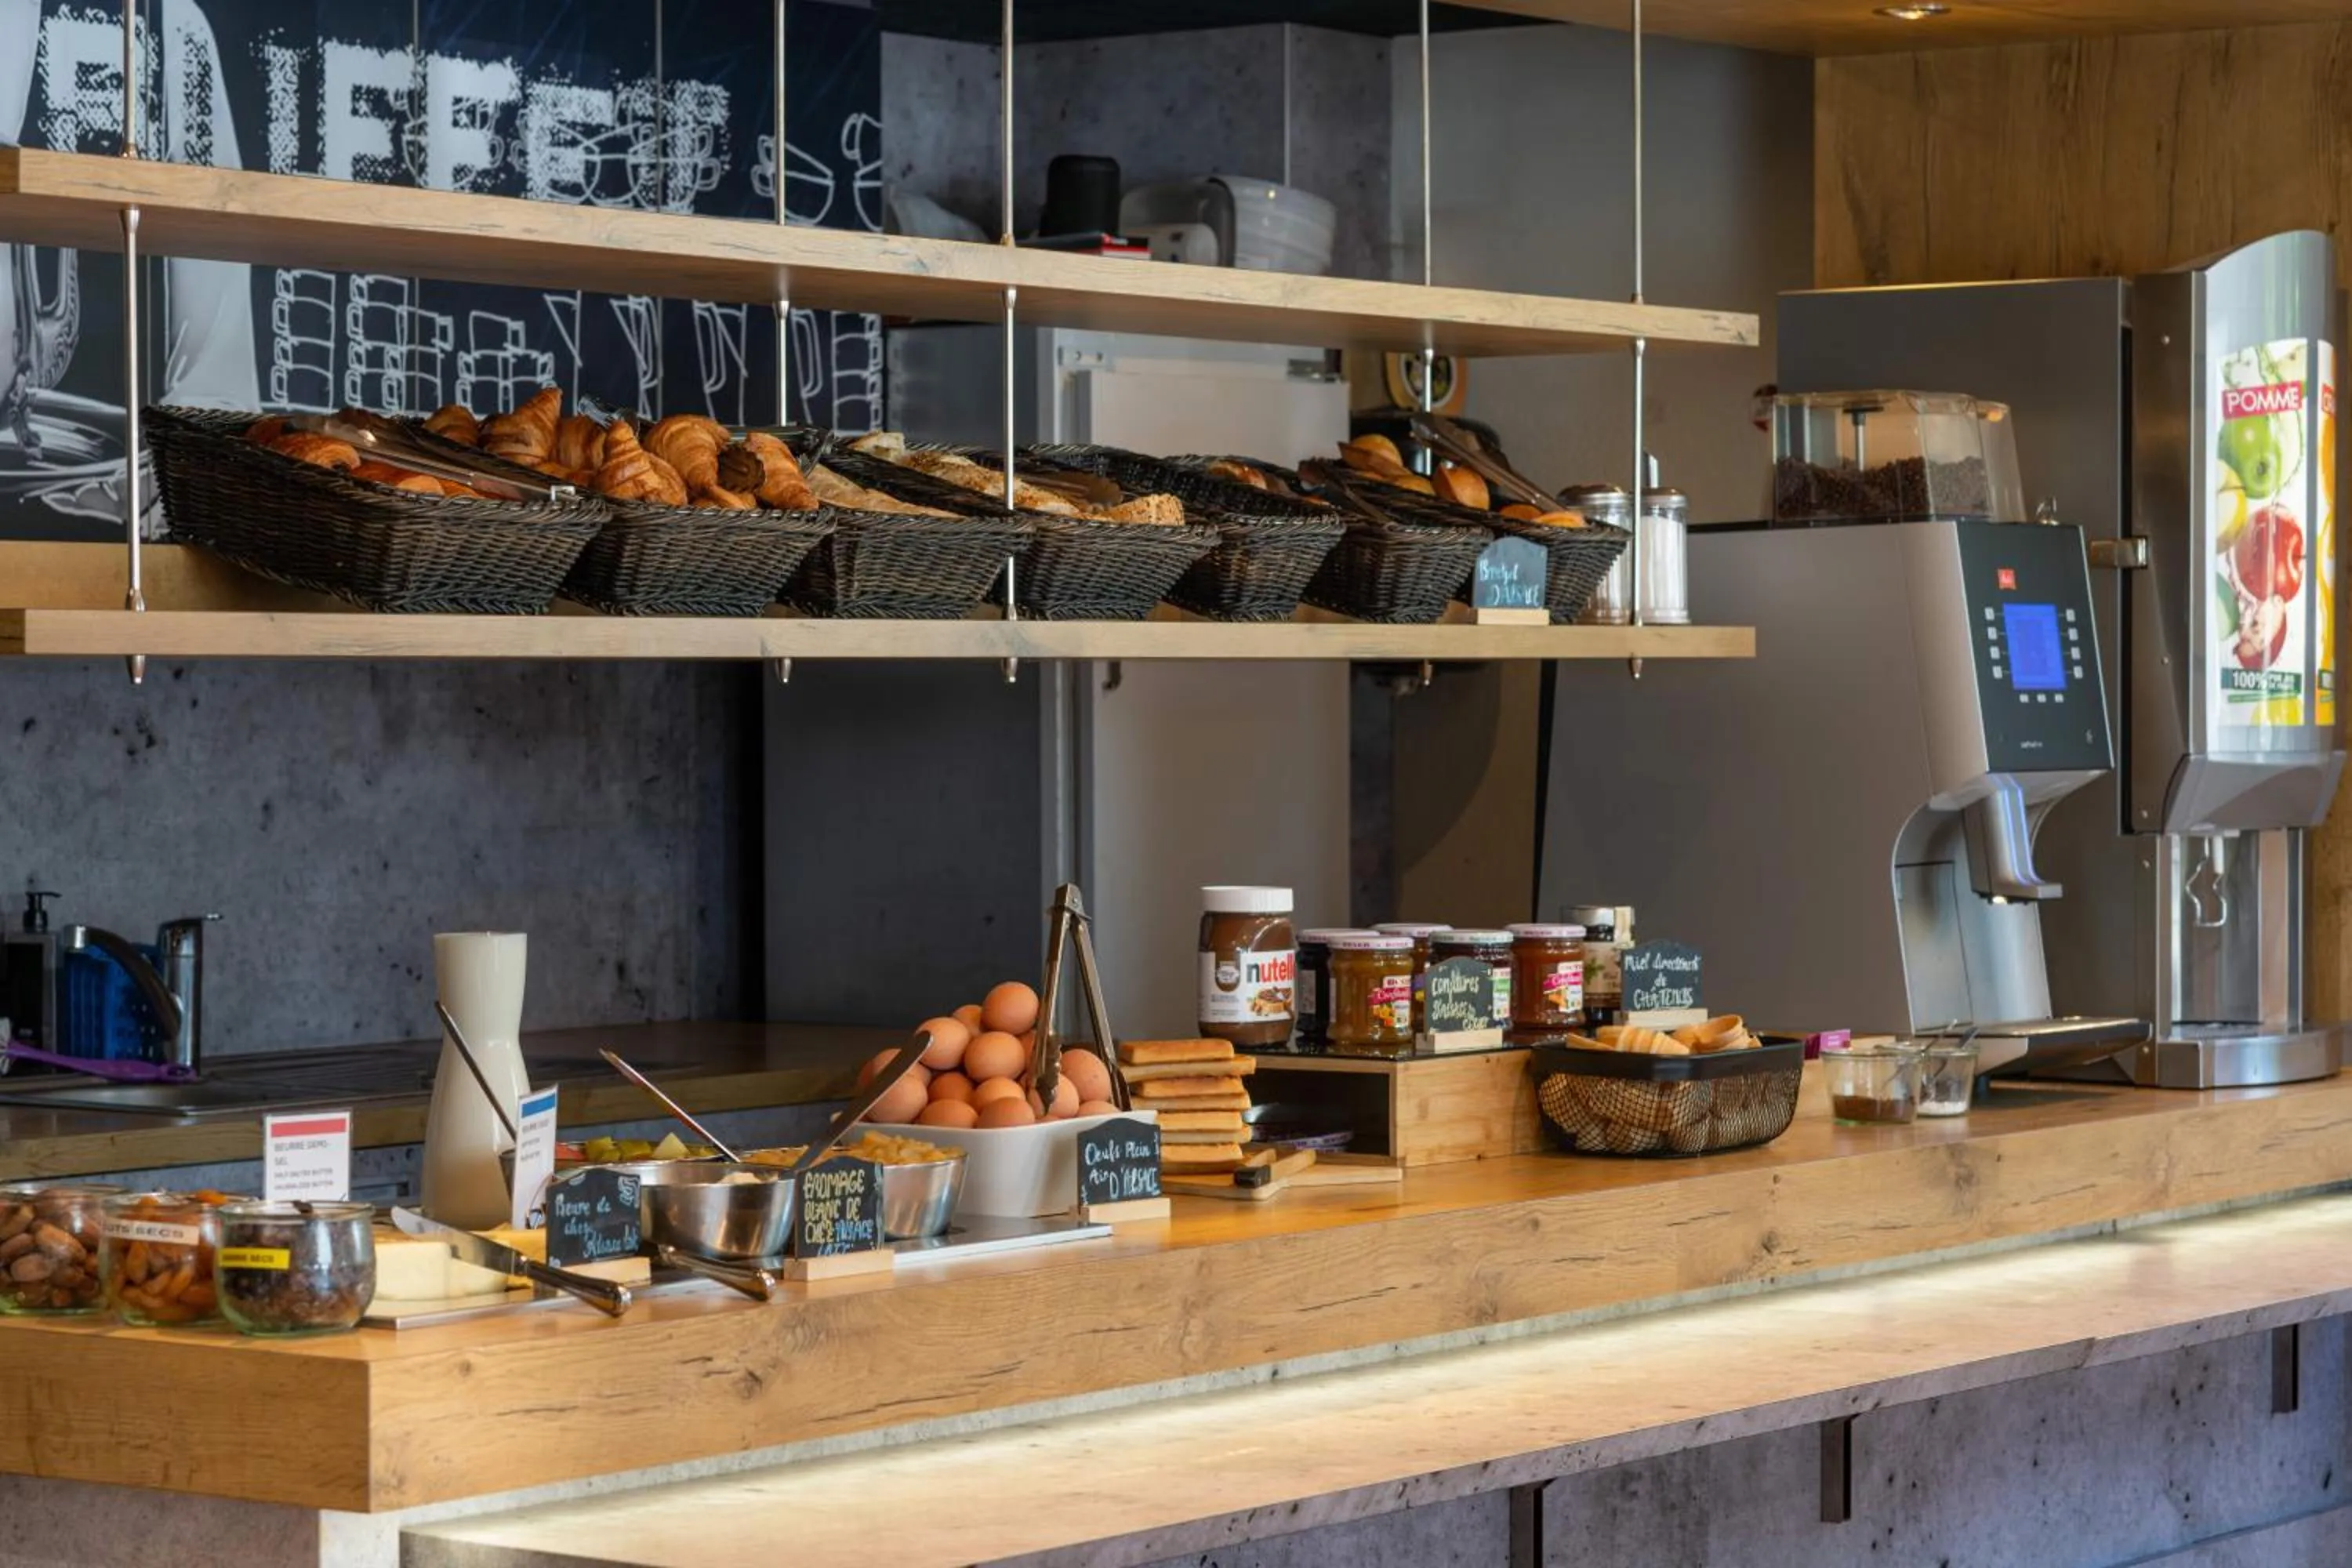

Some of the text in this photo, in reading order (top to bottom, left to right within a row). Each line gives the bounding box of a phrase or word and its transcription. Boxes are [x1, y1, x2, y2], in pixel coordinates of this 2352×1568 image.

[2227, 387, 2299, 413] POMME
[1247, 953, 1296, 983] nutell
[803, 1169, 866, 1200] FROMAGE
